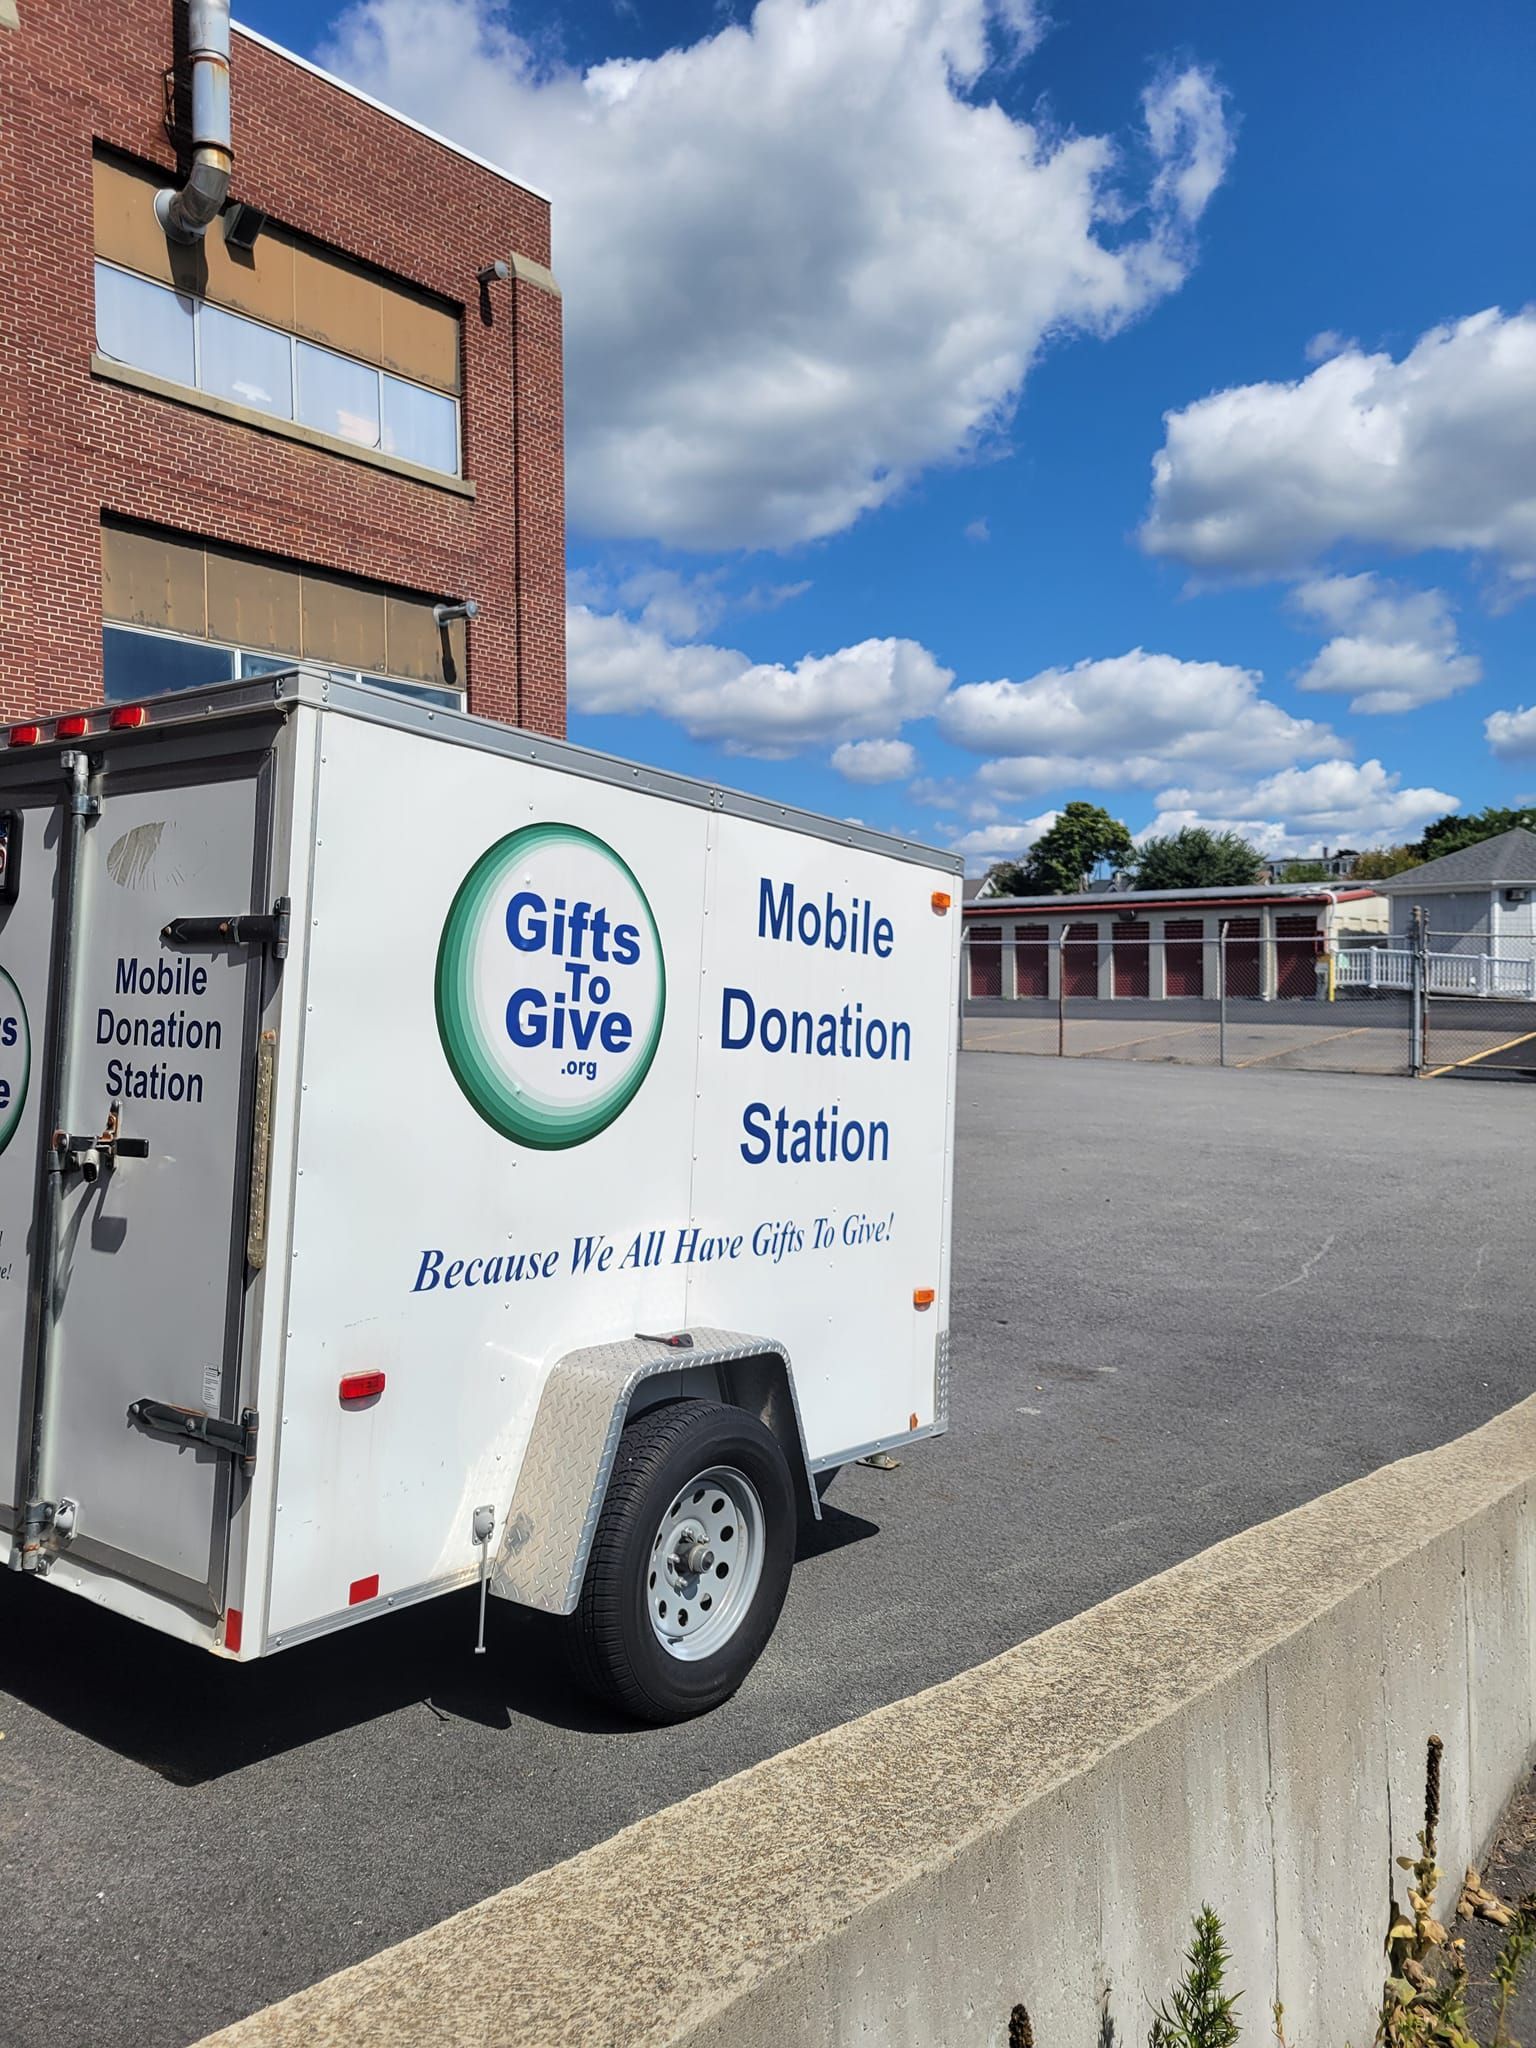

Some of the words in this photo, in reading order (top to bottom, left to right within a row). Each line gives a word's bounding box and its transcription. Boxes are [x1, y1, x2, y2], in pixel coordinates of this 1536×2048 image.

[505, 891, 641, 965] Gifts
[759, 878, 893, 958] Mobile
[115, 957, 208, 995] Mobile
[565, 962, 611, 1005] To
[97, 1009, 221, 1050] Donation
[505, 988, 632, 1053] Give
[722, 988, 911, 1061] Donation
[106, 1059, 203, 1102] Station
[561, 1058, 597, 1081] .org
[741, 1102, 889, 1164] Station
[410, 1250, 559, 1293] Because
[570, 1235, 611, 1275] We
[619, 1231, 665, 1268] All
[671, 1228, 743, 1265] Have
[752, 1221, 804, 1264] Gifts
[813, 1218, 835, 1251] To
[842, 1212, 894, 1245] Give!
